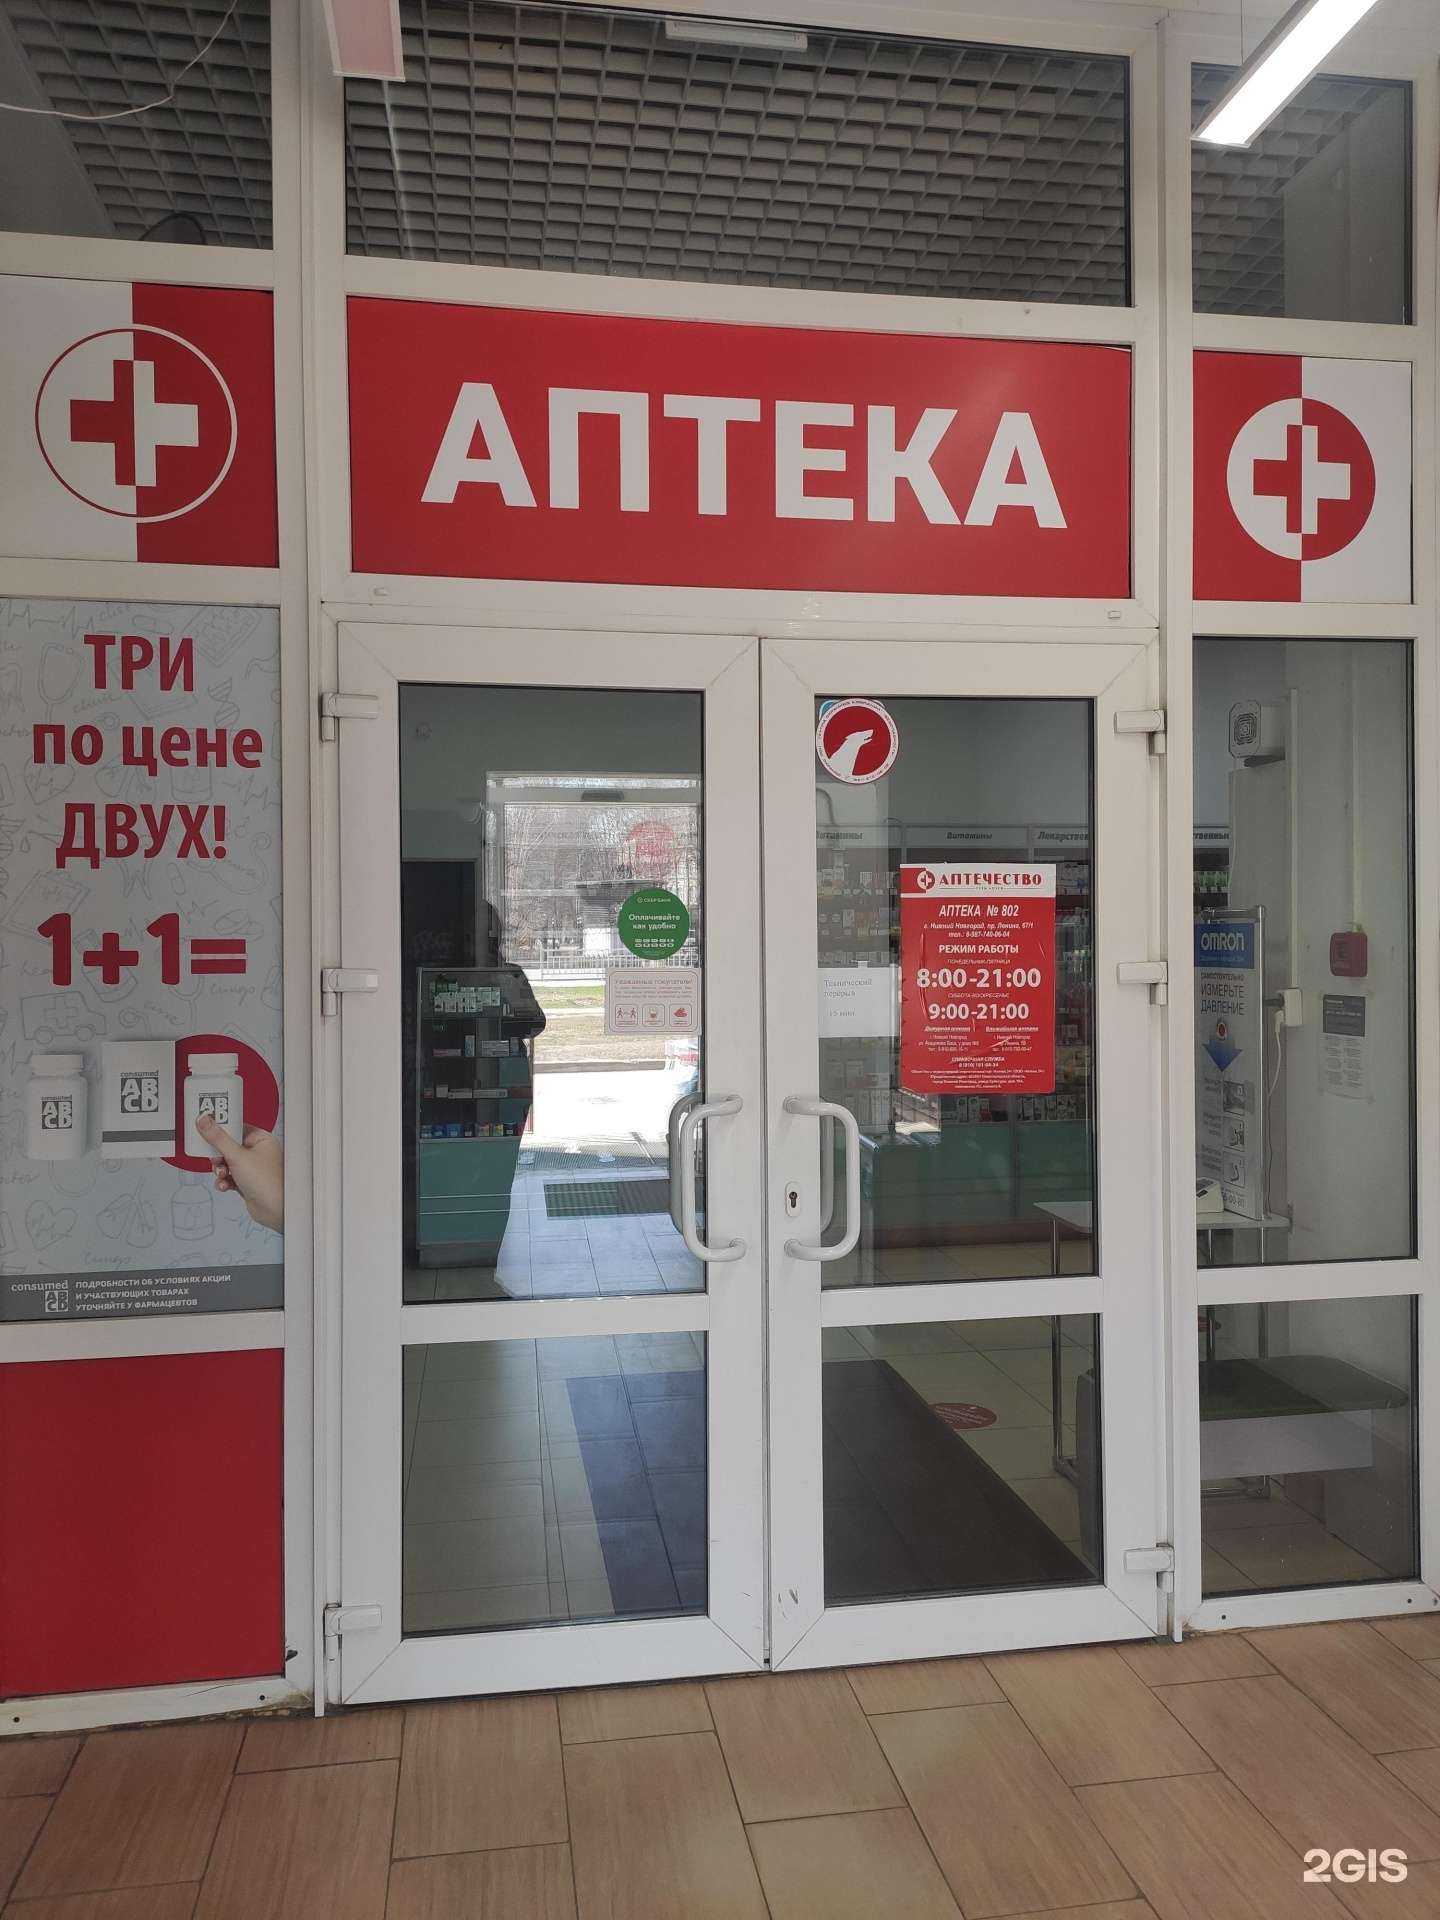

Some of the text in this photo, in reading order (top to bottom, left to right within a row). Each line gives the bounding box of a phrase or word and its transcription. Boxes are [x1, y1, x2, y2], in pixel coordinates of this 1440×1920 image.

[421, 381, 1068, 530] АПТЕКА
[84, 635, 194, 692] ТРИ
[33, 725, 263, 776] по цене
[56, 803, 227, 869] ДВУХ!
[939, 873, 1042, 886] АПТЕЧЕСТВО
[628, 913, 681, 921] Оплачивайте
[939, 904, 1019, 917] АПТЕКА № 802
[648, 922, 677, 931] удобно
[938, 944, 1019, 954] РЕЖИМ РАБОТЫ
[917, 968, 1041, 988] 8:00-21:00
[1200, 983, 1244, 998] ИЗМЕРЬТЕ
[929, 1003, 1030, 1020] 9:00-21:00
[1200, 1000, 1244, 1016] ДАВЛЕНИЕ
[11, 1279, 68, 1292] consumed
[75, 1275, 232, 1290] ПОДРОБНОСТИ ОБ УСЛОВИЯХ АКЦИИ
[83, 1290, 150, 1300] УЧАСТВУЮЩИХ
[151, 1288, 190, 1297] ТОВАРАХ
[75, 1302, 126, 1311] УТОЧНЯЙТЕ
